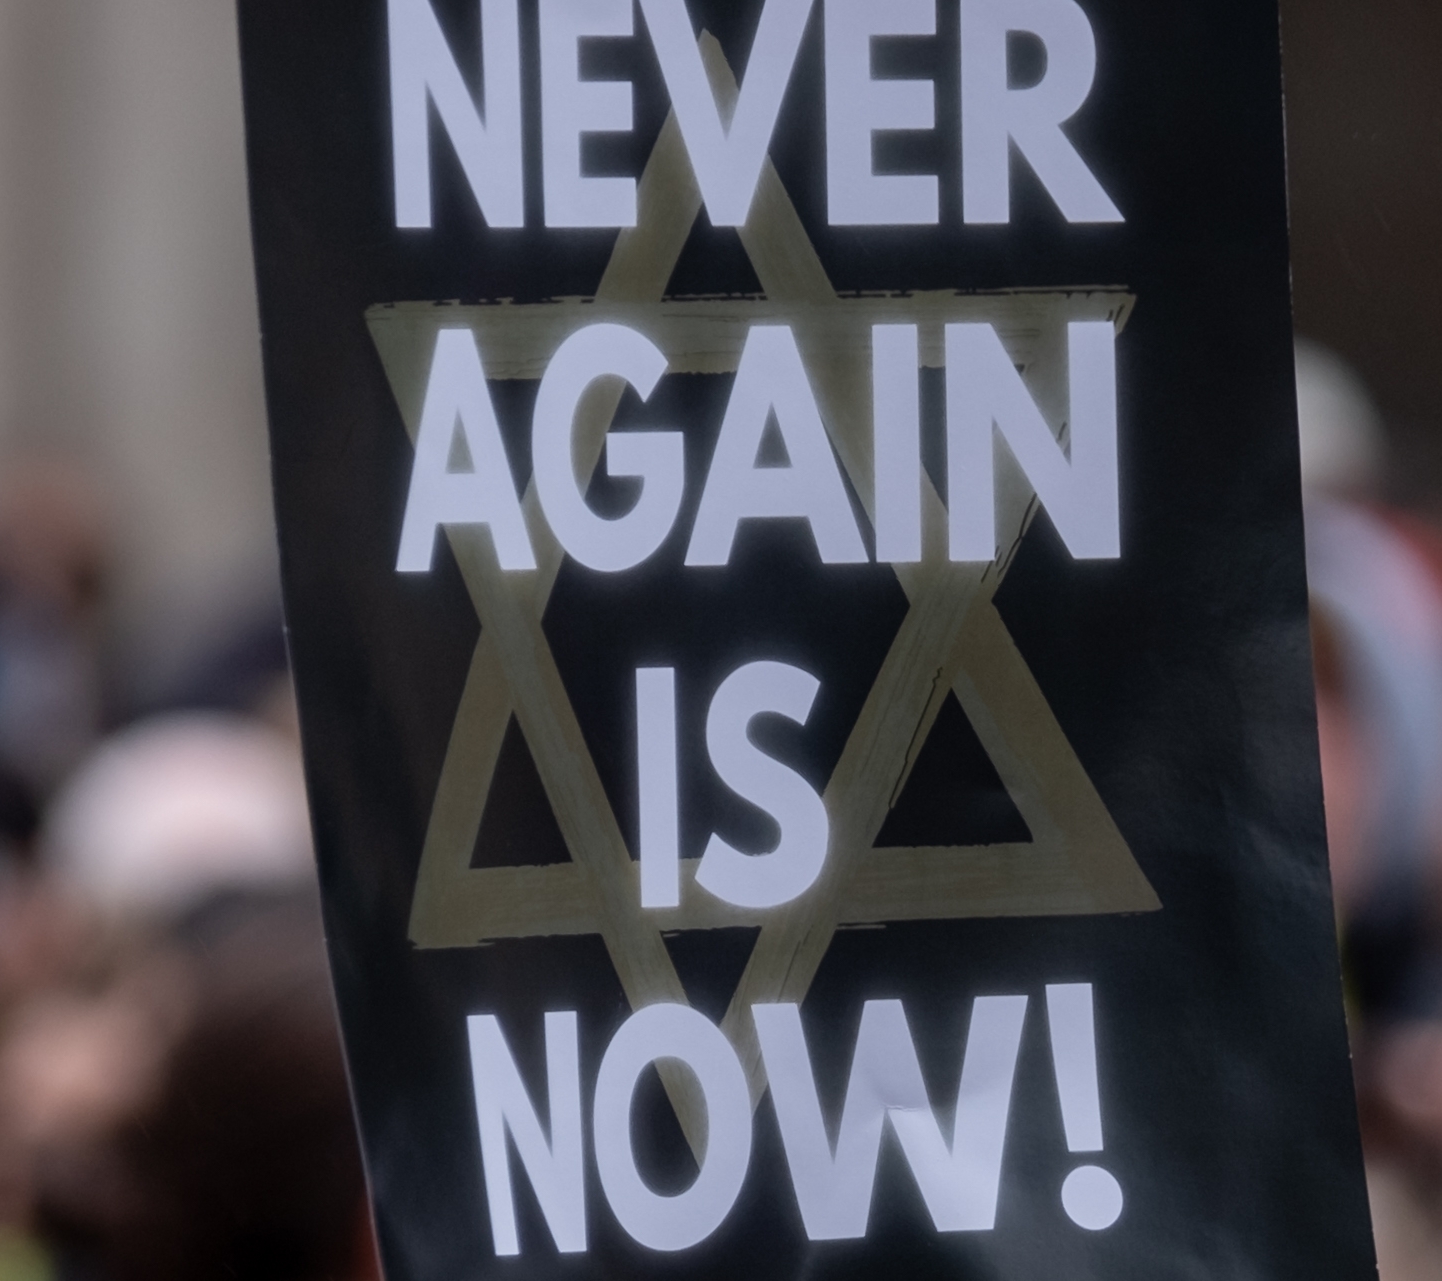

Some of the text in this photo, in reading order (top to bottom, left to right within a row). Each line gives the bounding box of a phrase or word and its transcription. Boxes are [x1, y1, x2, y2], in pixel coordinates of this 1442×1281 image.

[395, 320, 1121, 573] AGAIN
[635, 660, 830, 910] IS
[466, 982, 1124, 1256] NOW!
